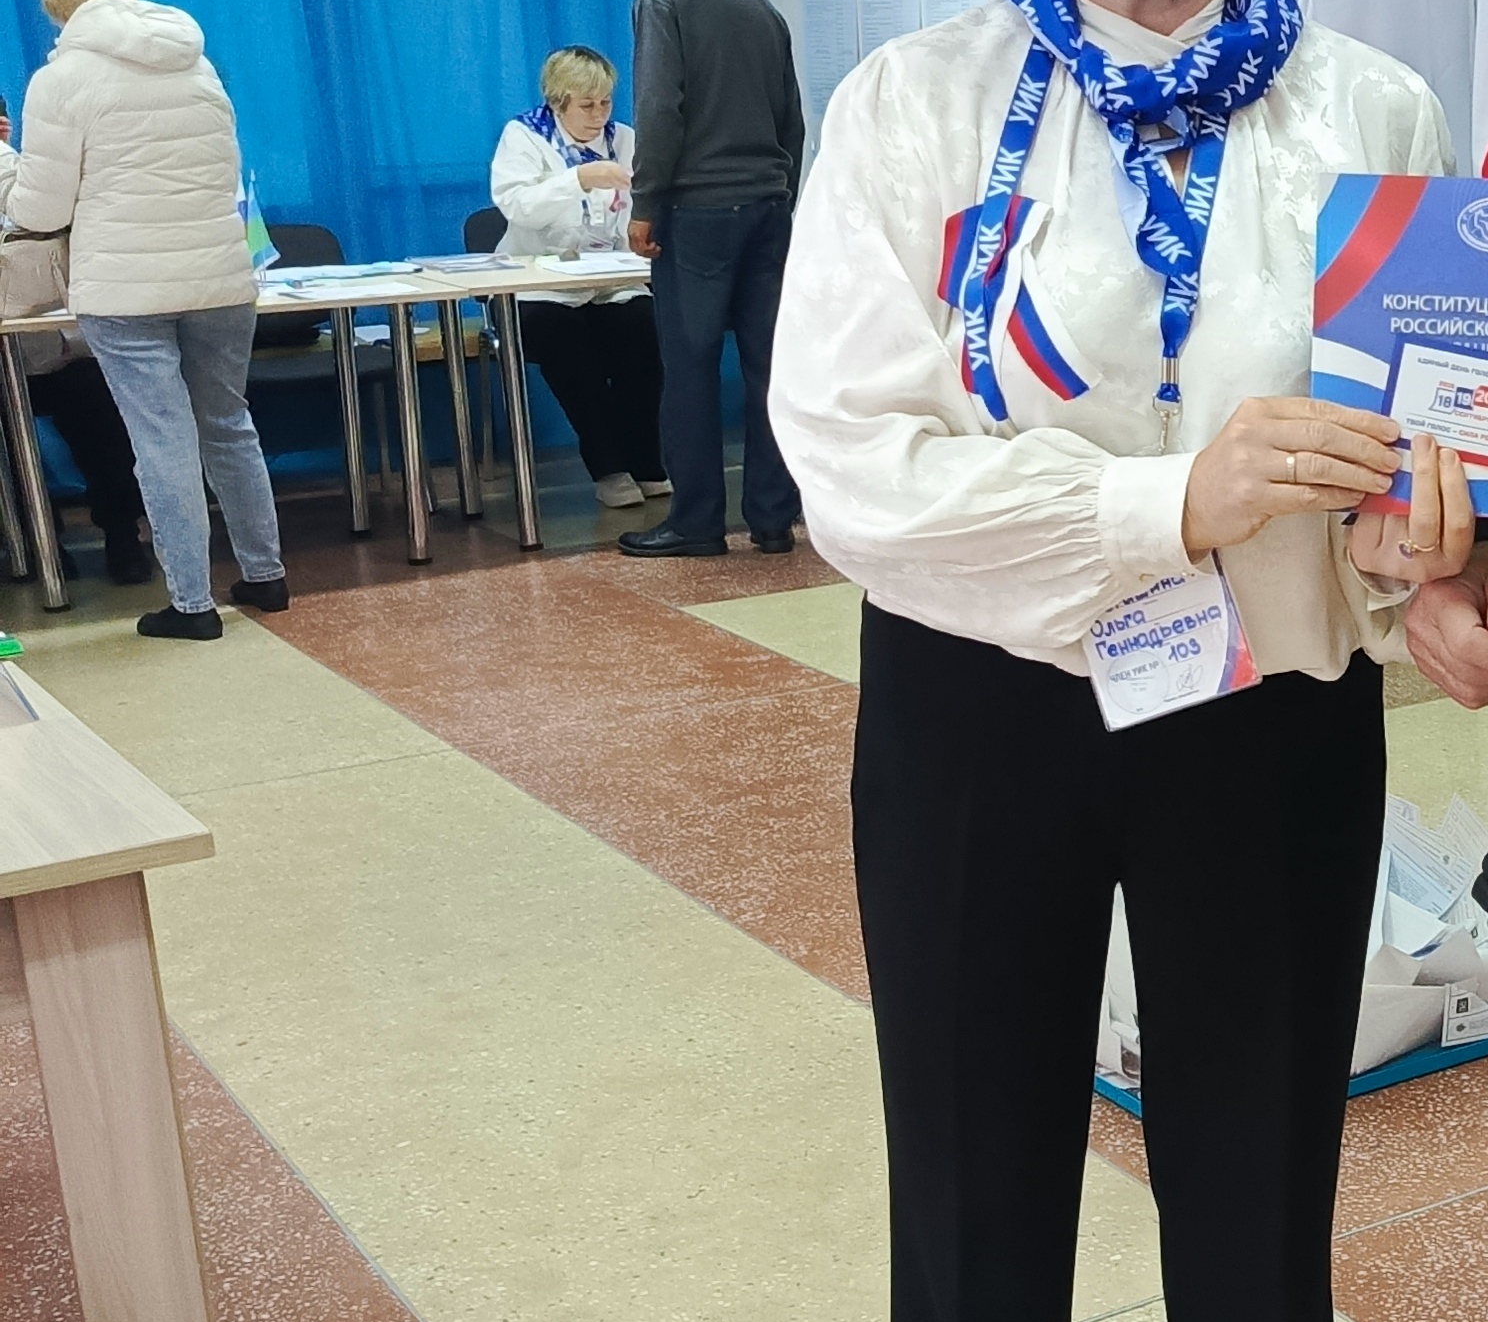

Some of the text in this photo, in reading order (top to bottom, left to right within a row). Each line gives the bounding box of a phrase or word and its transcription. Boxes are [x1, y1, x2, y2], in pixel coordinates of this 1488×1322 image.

[1177, 36, 1223, 96] УИК
[1215, 50, 1263, 107] УИК
[1009, 73, 1047, 126] УИК
[987, 146, 1026, 197] УИК
[1184, 173, 1217, 226] УИК
[1139, 214, 1193, 265] УИК
[965, 303, 990, 371] УИК
[1438, 395, 1452, 409] 18
[1456, 391, 1472, 406] 19
[1406, 417, 1426, 427] ТВОЙ
[1427, 421, 1452, 433] ГОЛОС
[1459, 429, 1478, 438] СИЛА
[1090, 609, 1147, 638] Ольга
[1095, 604, 1222, 661] Геннадьевна
[1108, 668, 1132, 684] ЧЛЕН
[1131, 664, 1149, 676] УИК
[1168, 638, 1201, 662] 103
